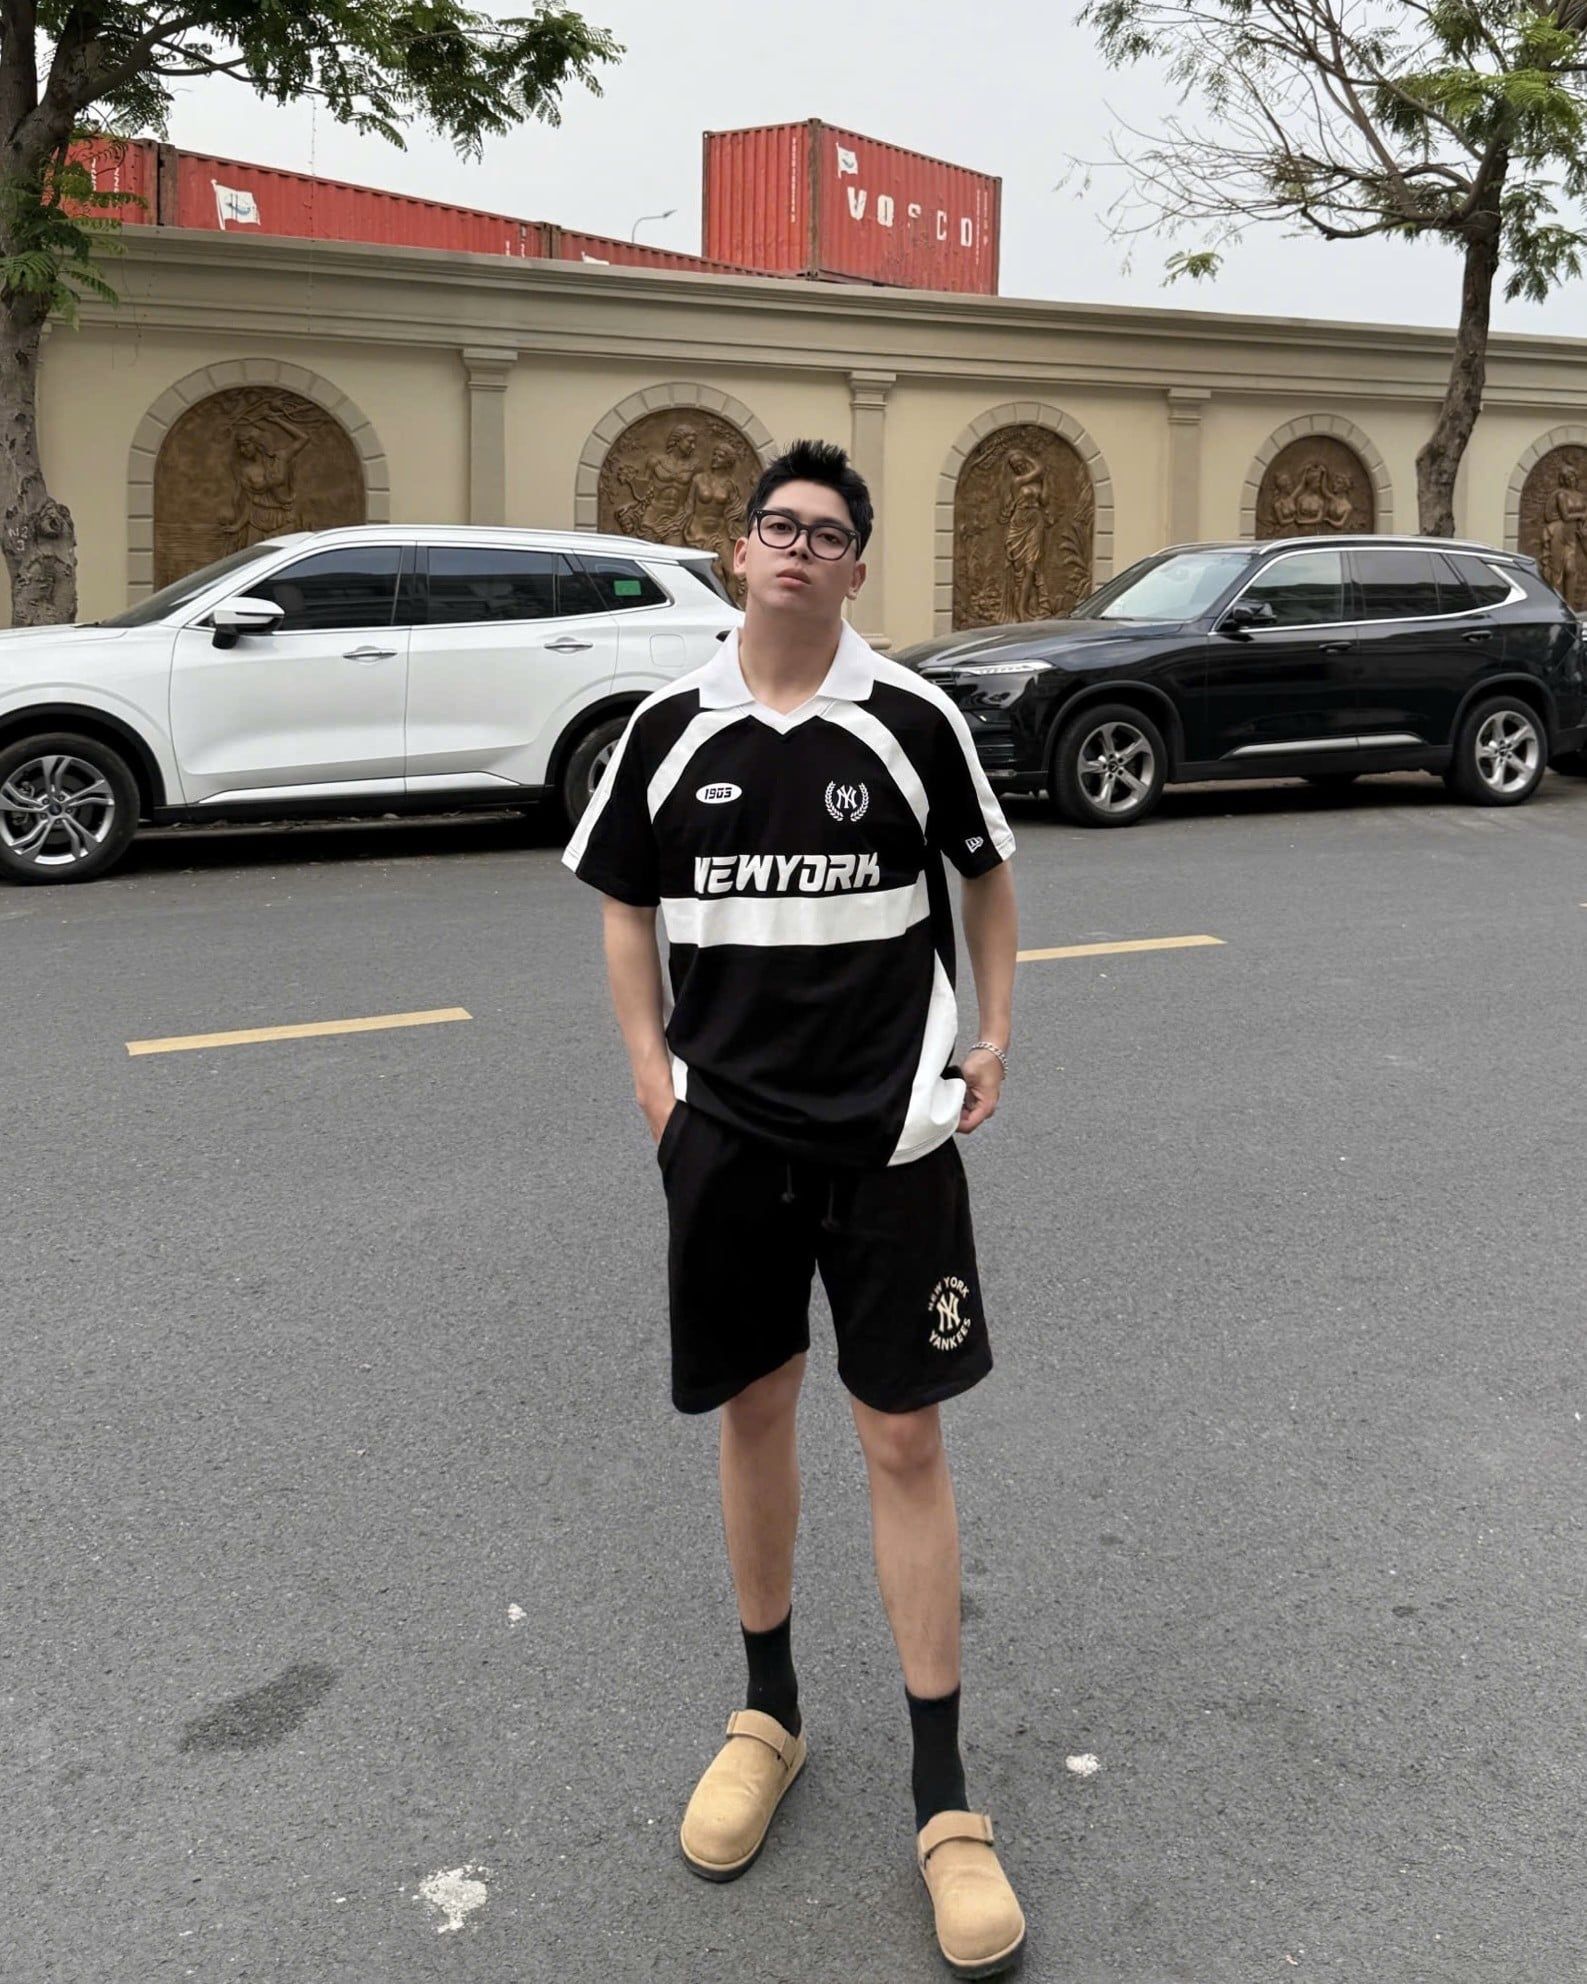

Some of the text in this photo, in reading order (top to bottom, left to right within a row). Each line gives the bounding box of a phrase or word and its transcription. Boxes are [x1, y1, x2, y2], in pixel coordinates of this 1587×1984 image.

[704, 786, 733, 800] 1903
[836, 784, 857, 810] NY
[928, 1276, 970, 1311] NEW YORK
[936, 1291, 961, 1332] NY
[929, 1318, 971, 1351] YANKEES
